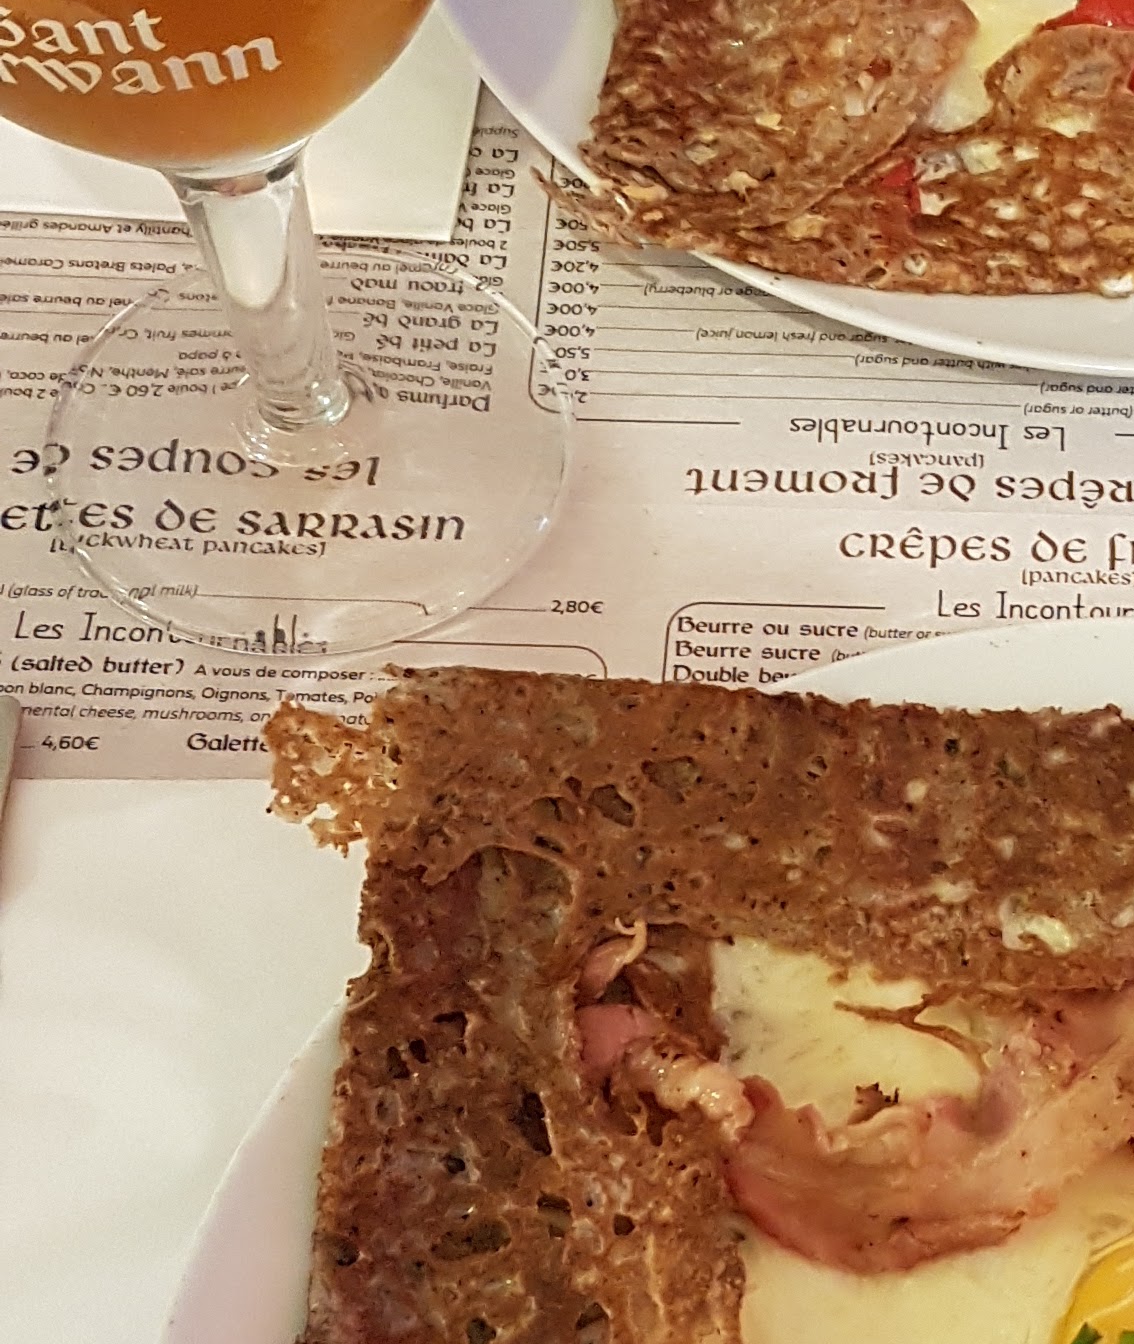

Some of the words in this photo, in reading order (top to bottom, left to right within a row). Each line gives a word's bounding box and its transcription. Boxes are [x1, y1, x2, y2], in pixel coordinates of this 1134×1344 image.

[551, 260, 599, 272] 4,20€
[549, 282, 599, 293] 4,00€
[546, 302, 598, 315] 4,00€
[544, 324, 595, 336] 4,00€
[789, 417, 1010, 450] Incontournables
[1023, 426, 1065, 450] Les
[551, 600, 604, 615] 2,80€
[938, 589, 981, 618] Les
[14, 610, 64, 640] Les
[677, 616, 753, 635] Beurre
[762, 623, 789, 635] ou
[800, 623, 858, 638] sucre
[864, 625, 912, 641] (butter
[675, 640, 752, 658] Beurre
[761, 649, 820, 661] sucre
[11, 656, 93, 673] (salted
[102, 658, 185, 676] butter)
[194, 665, 207, 676] A
[208, 667, 251, 677] vous
[255, 666, 277, 678] de
[282, 667, 365, 681] composer
[673, 664, 749, 683] Double
[29, 683, 76, 698] blanc,
[81, 683, 196, 700] Champignons,
[201, 687, 271, 703] Oignons,
[79, 707, 137, 721] cheese,
[142, 708, 245, 723] mushrooms,
[41, 735, 100, 751] 4,60€
